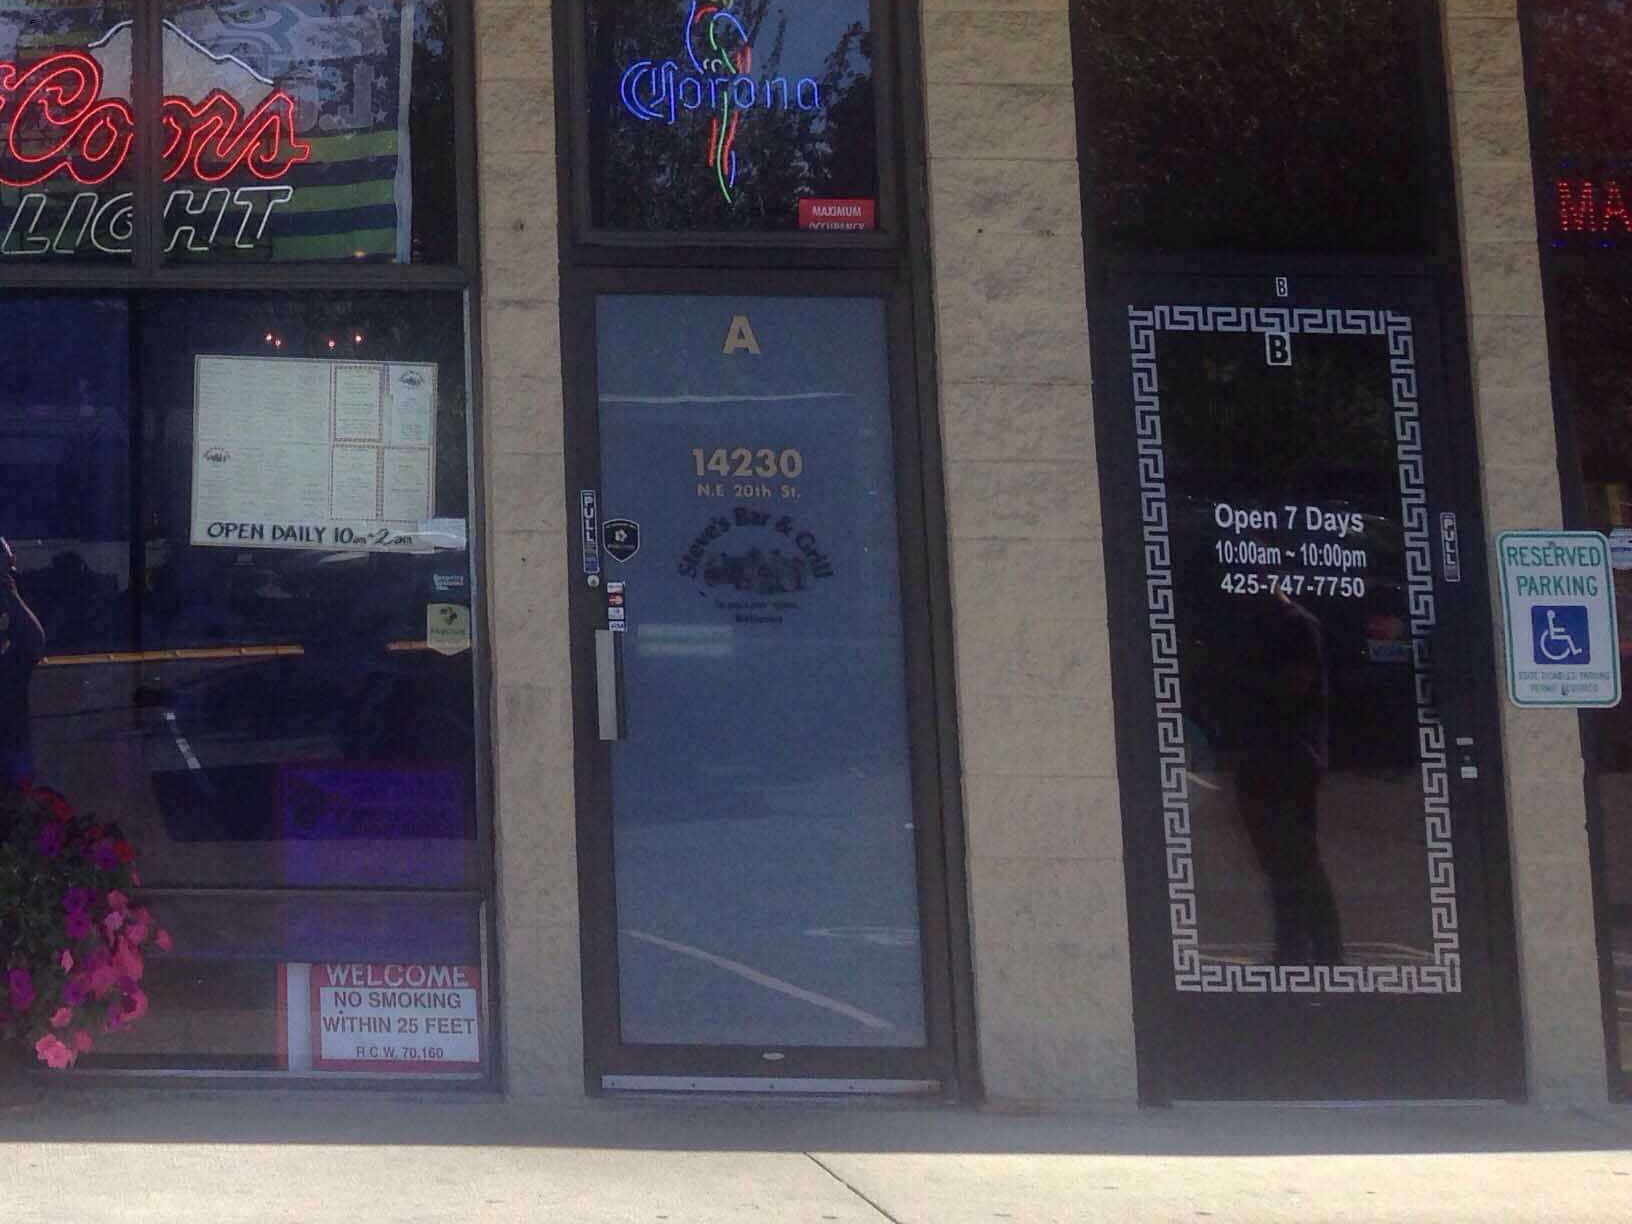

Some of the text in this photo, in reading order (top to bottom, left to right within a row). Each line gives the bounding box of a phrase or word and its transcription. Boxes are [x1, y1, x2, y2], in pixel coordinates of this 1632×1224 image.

[621, 60, 820, 124] Corona
[0, 185, 294, 255] LIGHT
[812, 205, 862, 216] MAXIMUM
[1277, 278, 1287, 296] B
[723, 314, 761, 354] A
[1269, 335, 1289, 363] B
[691, 448, 802, 478] 14230
[734, 484, 772, 498] 20th
[583, 496, 594, 542] PULL
[1215, 504, 1365, 538] Open 7 Days
[207, 521, 264, 539] OPEN
[272, 524, 327, 543] DAILY
[1444, 519, 1456, 564] PULL
[1216, 541, 1281, 565] 10:00am
[1300, 543, 1366, 571] 10:00pm
[1506, 546, 1601, 567] RESERVED
[1221, 575, 1365, 597] 425-747-7750
[1517, 575, 1598, 597] PARKING
[325, 964, 468, 987] WELCOME
[334, 991, 461, 1009] NO SMOKING
[323, 1016, 475, 1035] WITHIN 25 FEET
[403, 1046, 444, 1059] 70.160
